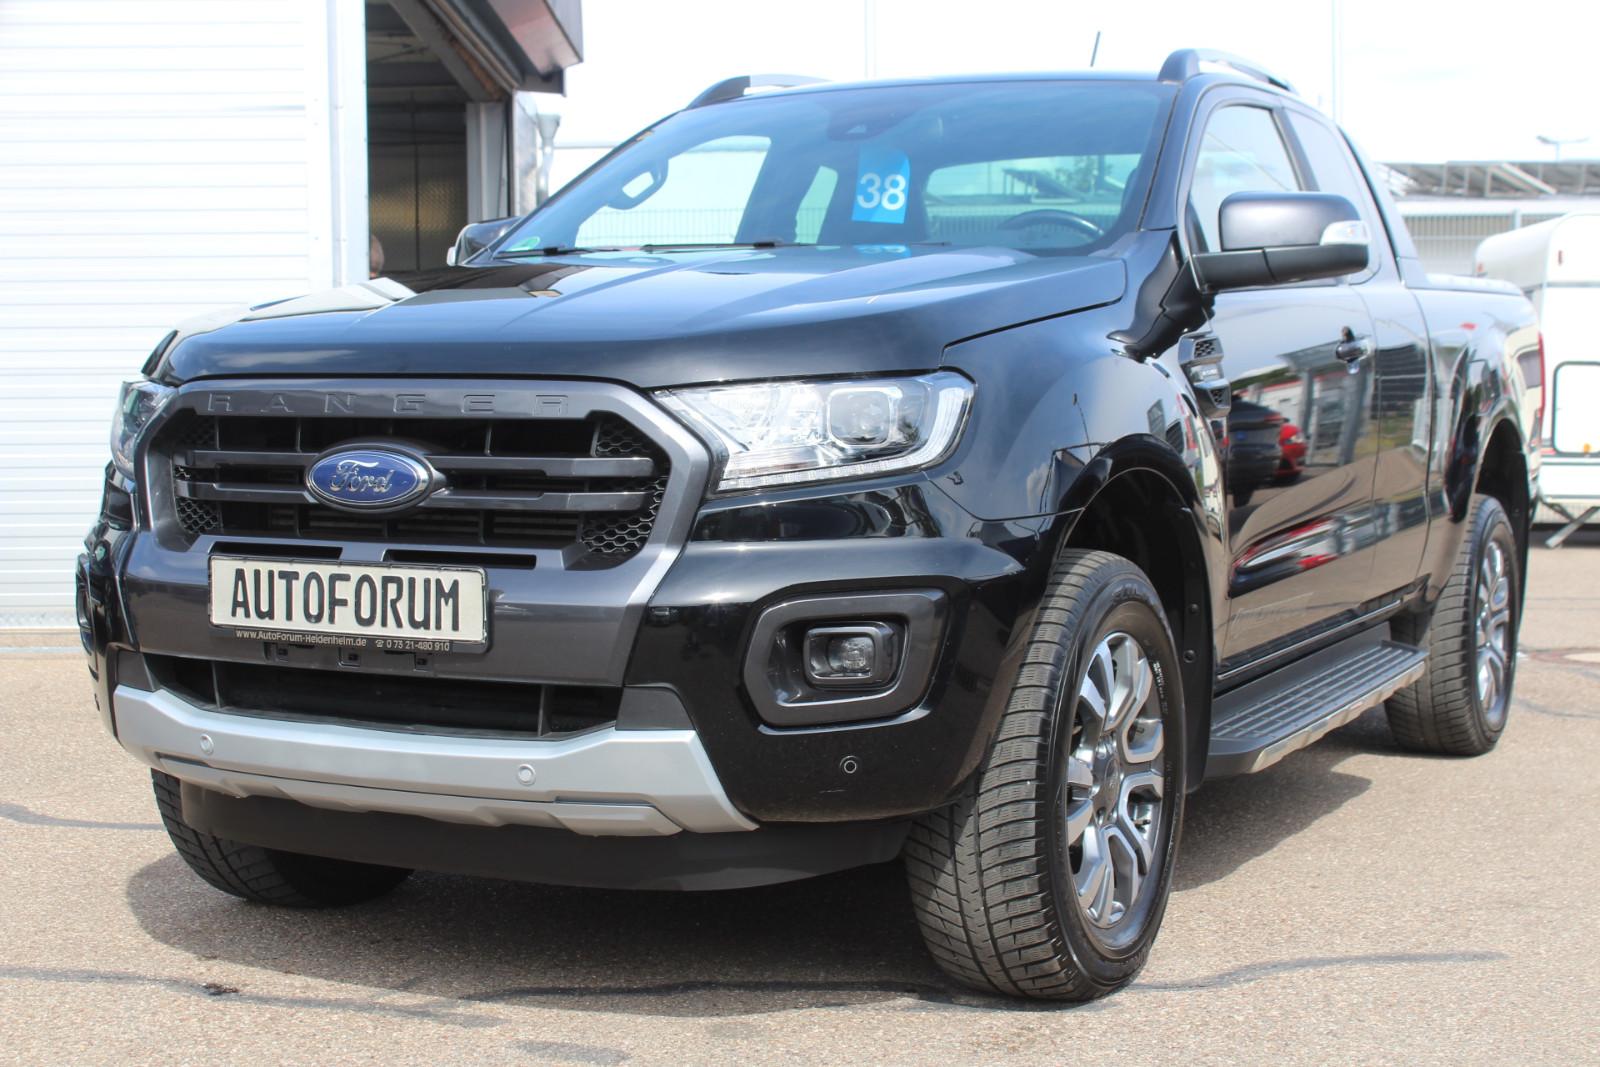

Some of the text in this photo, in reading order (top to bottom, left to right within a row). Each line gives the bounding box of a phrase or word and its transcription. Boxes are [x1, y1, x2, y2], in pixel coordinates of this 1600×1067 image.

[857, 172, 906, 210] 38
[207, 393, 569, 416] RANGER
[329, 459, 393, 495] Ford
[231, 568, 460, 632] AUTOFORUM
[235, 630, 367, 647] www.AutoForum-Heidenheim.de
